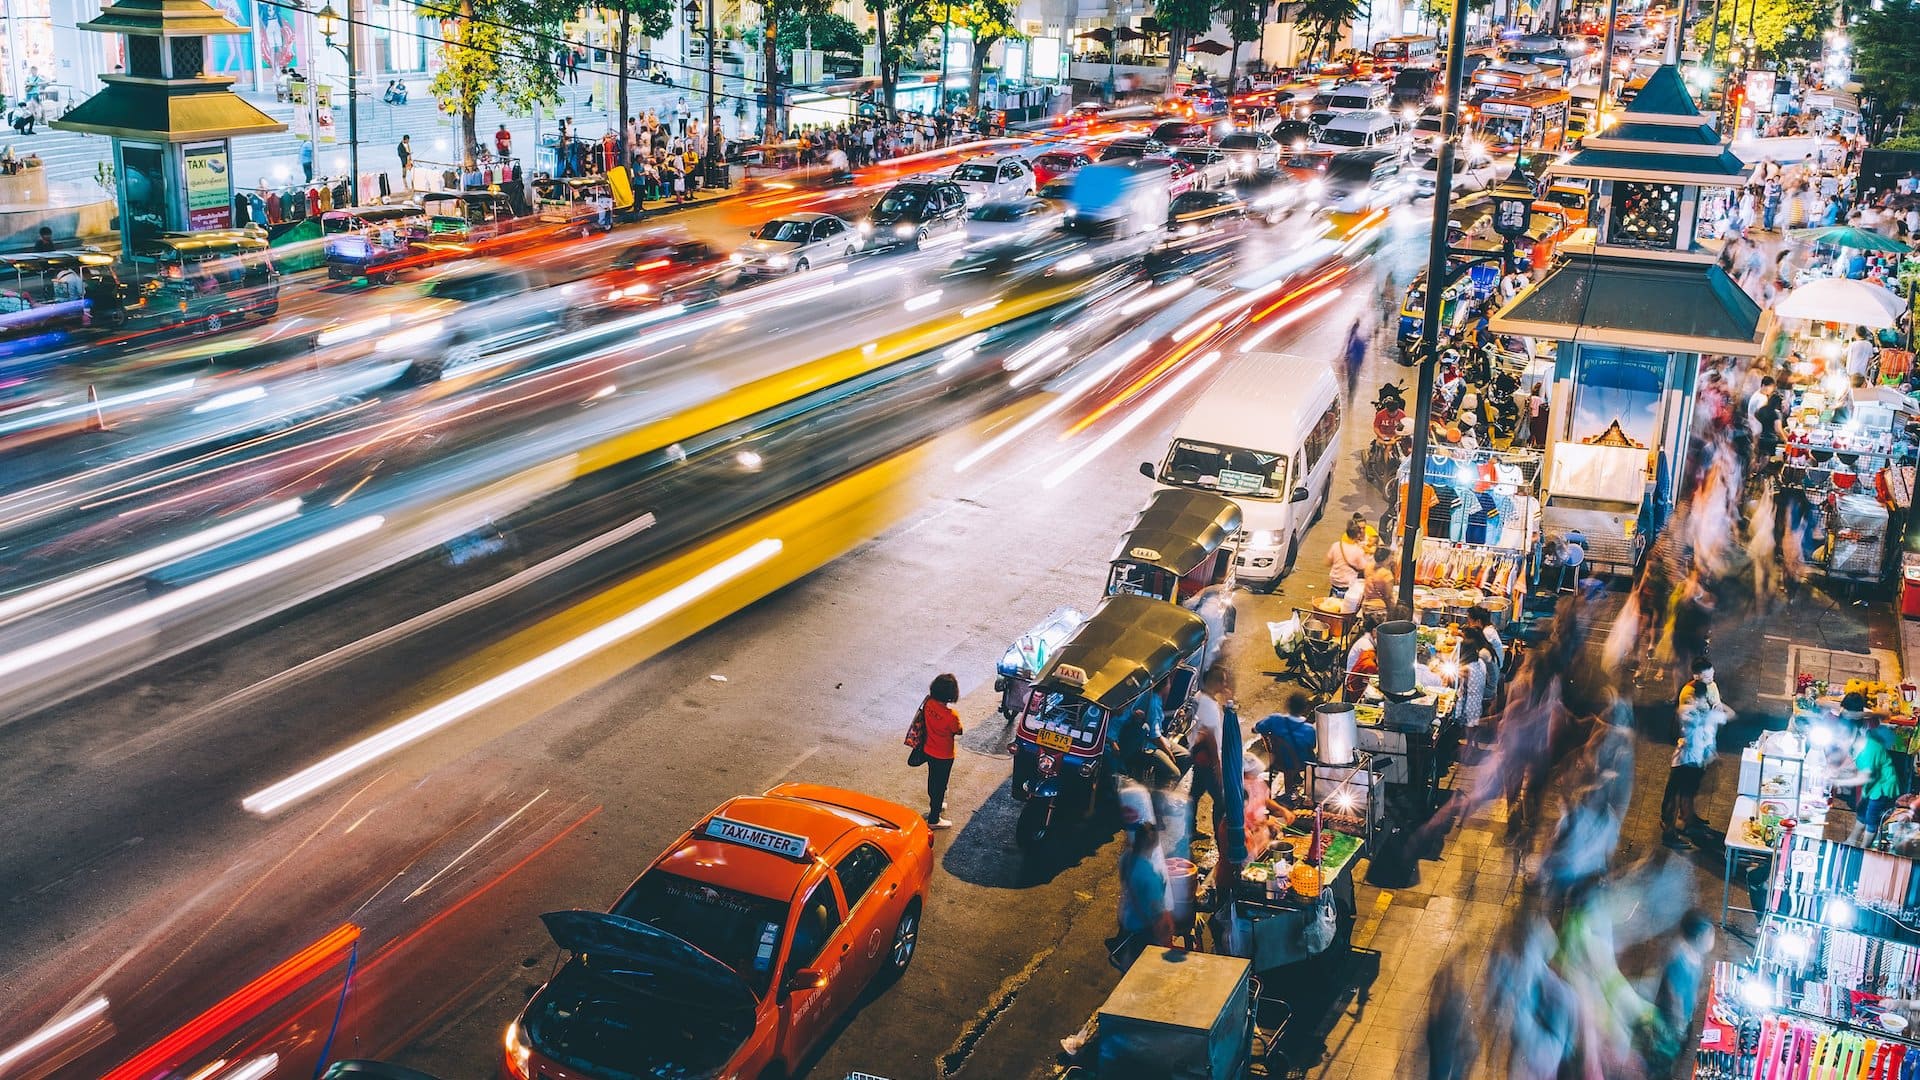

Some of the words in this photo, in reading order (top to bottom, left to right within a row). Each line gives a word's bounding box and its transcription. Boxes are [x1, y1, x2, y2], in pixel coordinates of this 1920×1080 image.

[187, 159, 207, 170] TAXI
[1060, 667, 1080, 679] TAXI
[1054, 734, 1068, 745] 573
